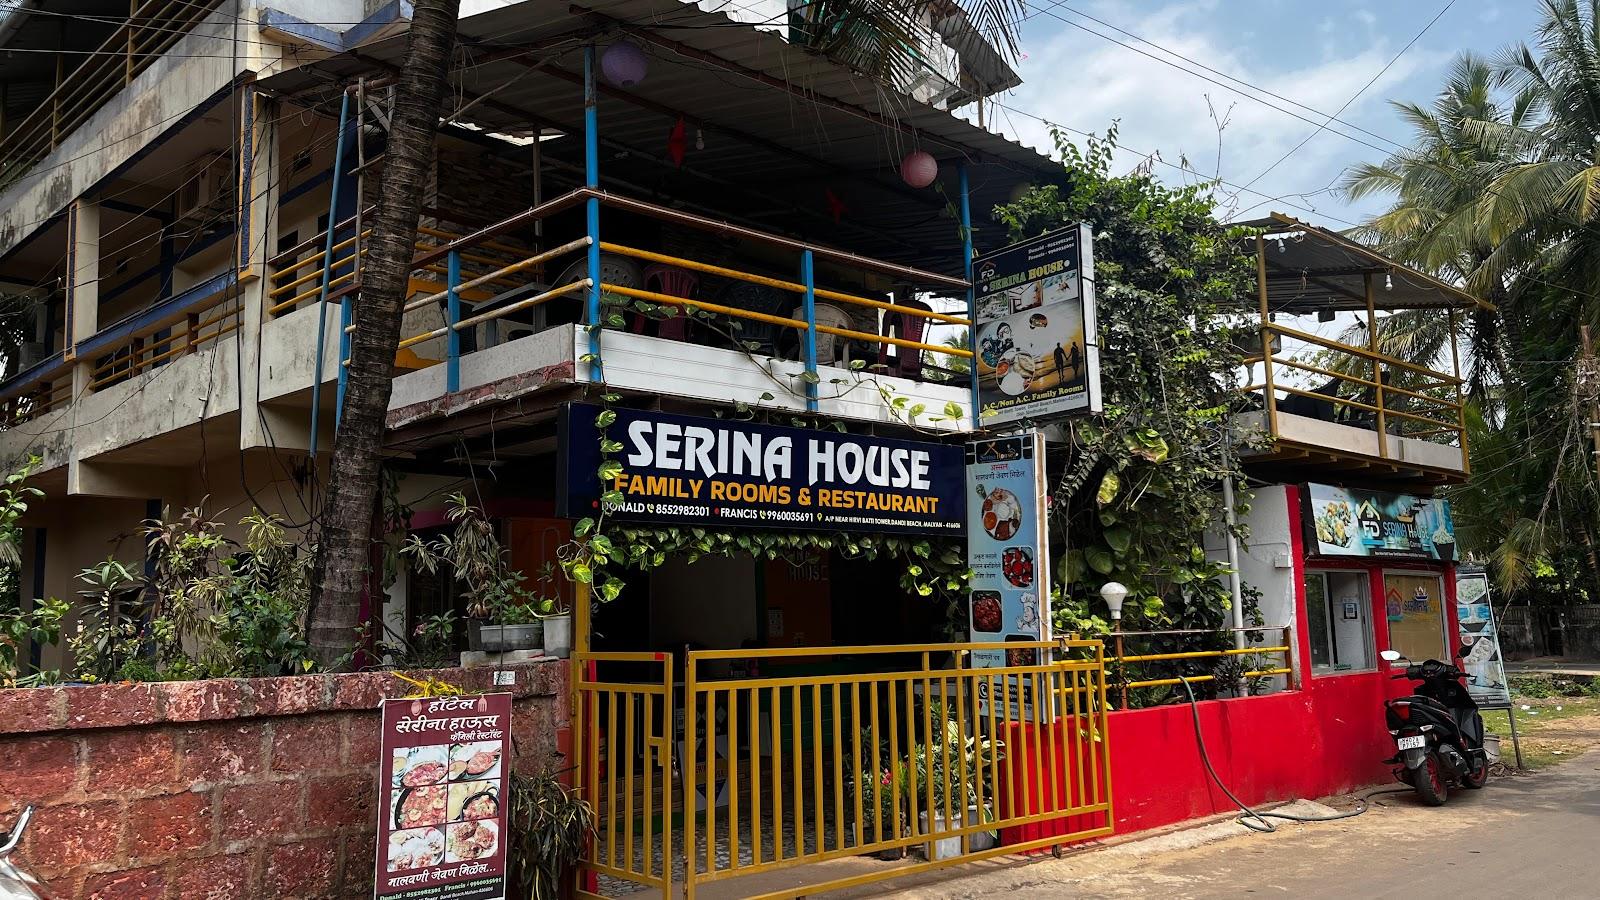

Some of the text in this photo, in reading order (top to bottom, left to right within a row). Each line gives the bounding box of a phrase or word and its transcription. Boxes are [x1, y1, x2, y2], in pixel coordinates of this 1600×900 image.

[989, 271, 1026, 291] SERINA
[1027, 260, 1064, 280] HOUSE
[1032, 390, 1057, 400] Family
[1058, 384, 1084, 394] Rooms
[627, 420, 931, 491] SERINA HOUSE
[614, 474, 939, 514] FAMILY ROOMS & RESTAURANT
[655, 504, 710, 517] 8552982301
[720, 507, 758, 519] FRANCIS
[767, 510, 814, 522] 9960035691
[427, 695, 478, 713] हॉटेल
[395, 714, 500, 733] सेरीना हाऊस
[387, 870, 430, 888] मालवणी
[431, 867, 457, 881] जेवण
[444, 882, 466, 892] Francis
